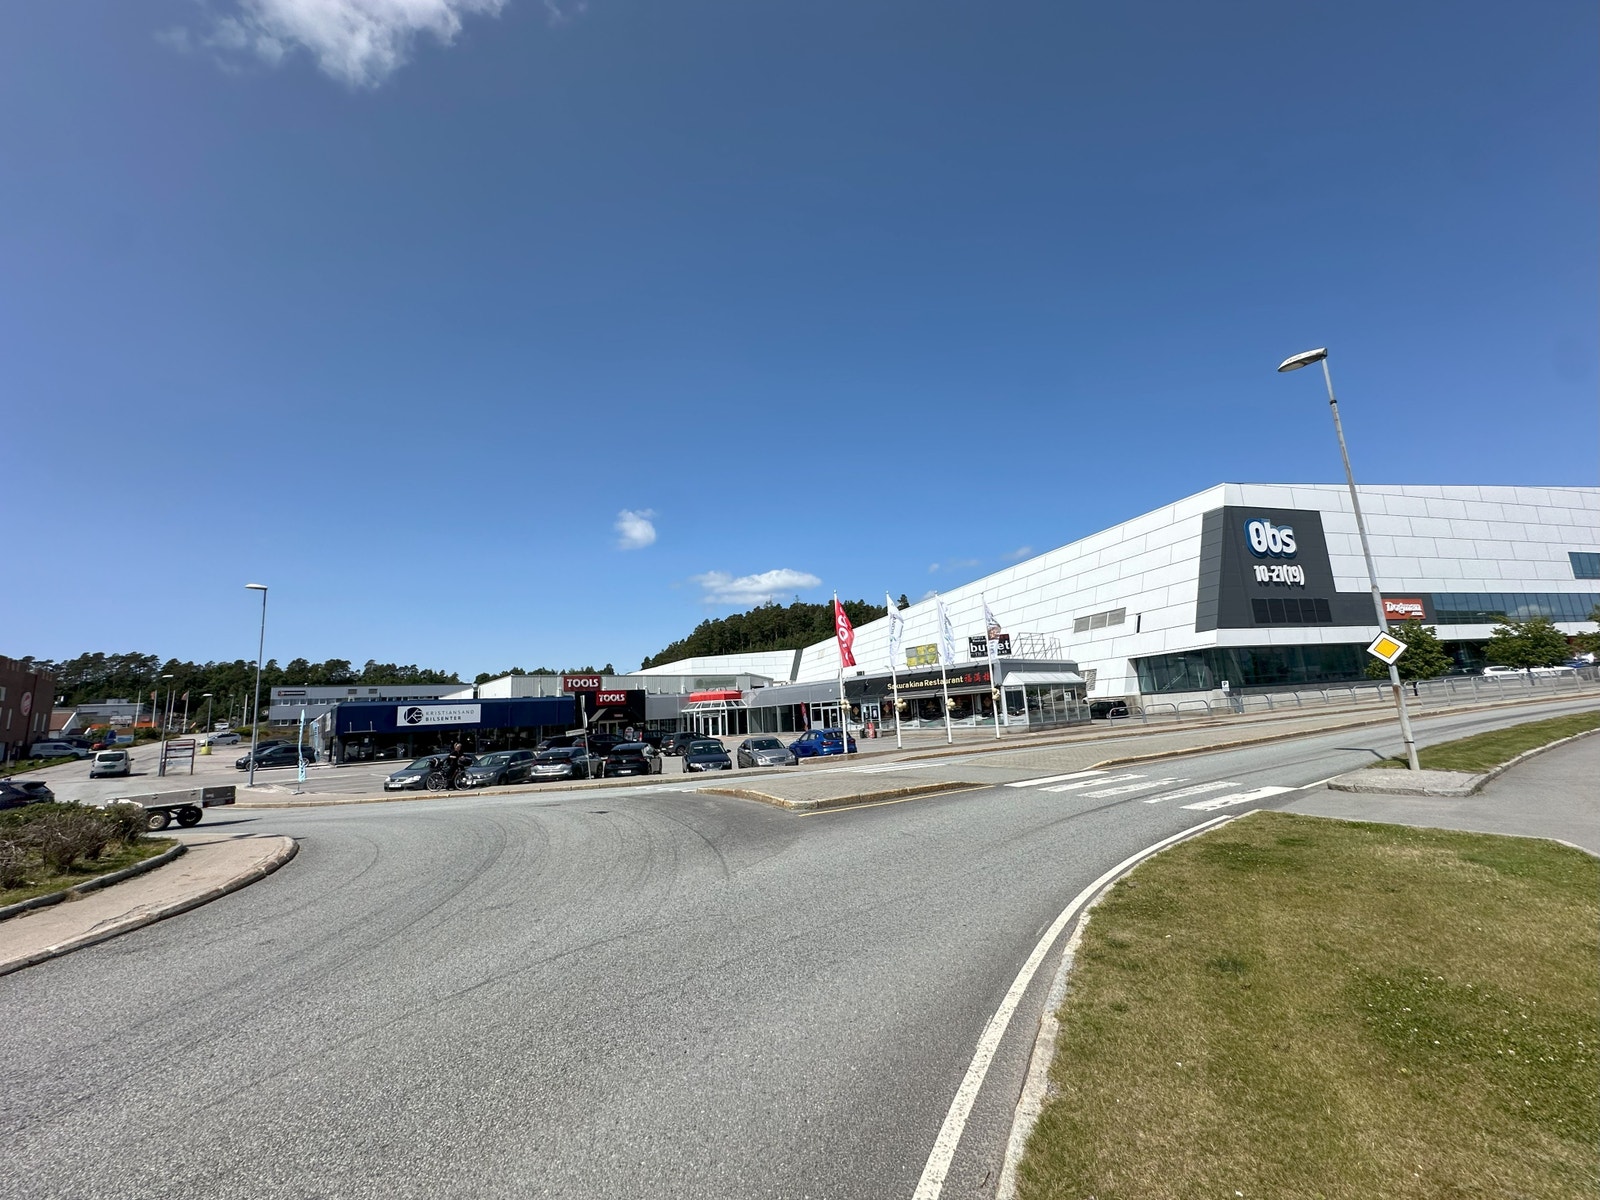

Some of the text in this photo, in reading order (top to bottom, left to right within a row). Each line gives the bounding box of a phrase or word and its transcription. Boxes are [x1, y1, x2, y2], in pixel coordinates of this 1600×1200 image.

[1247, 519, 1297, 554] Obs
[1253, 564, 1305, 585] 10-21(19)
[1385, 602, 1422, 614] Dogman
[970, 640, 1011, 653] buet
[566, 678, 598, 688] TOOLS
[598, 693, 625, 702] TOOLS
